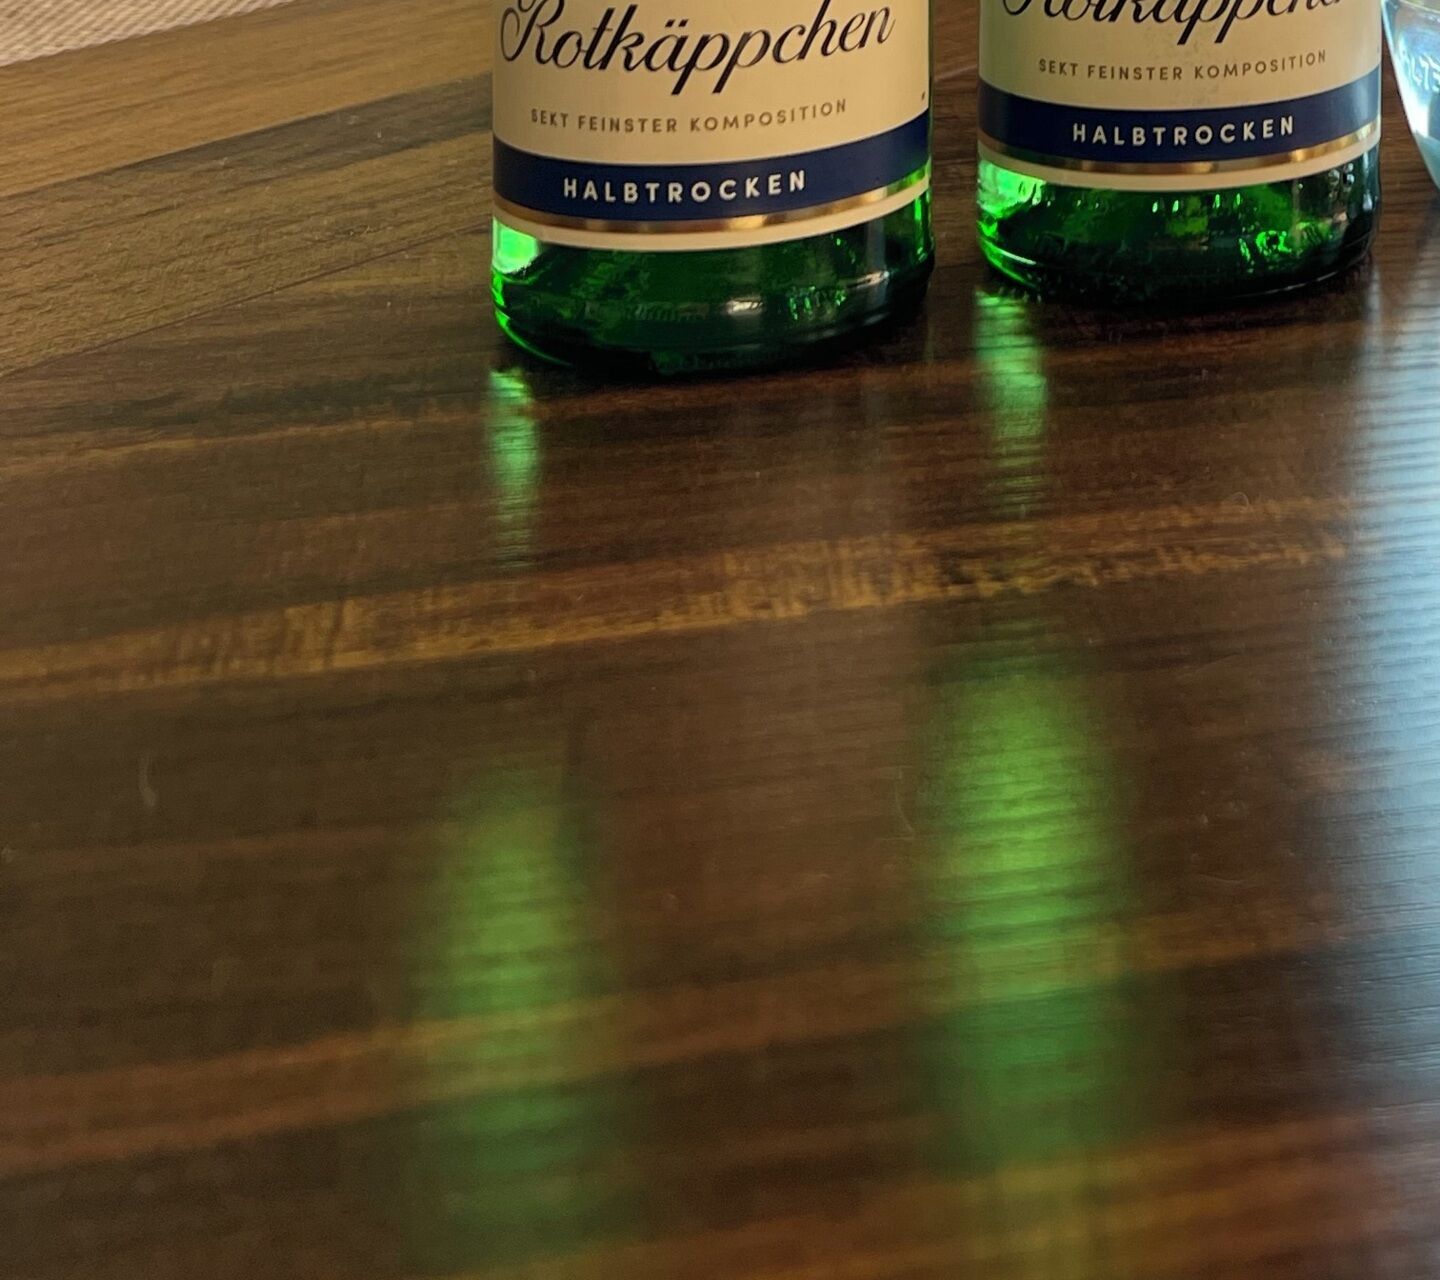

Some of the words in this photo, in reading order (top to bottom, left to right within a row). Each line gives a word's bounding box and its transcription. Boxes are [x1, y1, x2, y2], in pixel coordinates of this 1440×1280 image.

[1038, 58, 1077, 77] SEKT
[1087, 64, 1183, 81] FEINSTER
[1194, 49, 1327, 80] KOMPOSITION
[531, 107, 569, 129] SEKT
[577, 115, 678, 133] FEINSTER
[690, 97, 848, 132] KOMPOSITION
[1072, 114, 1295, 147] HALBTROCKEN
[563, 169, 807, 203] HALBTROCKEN
